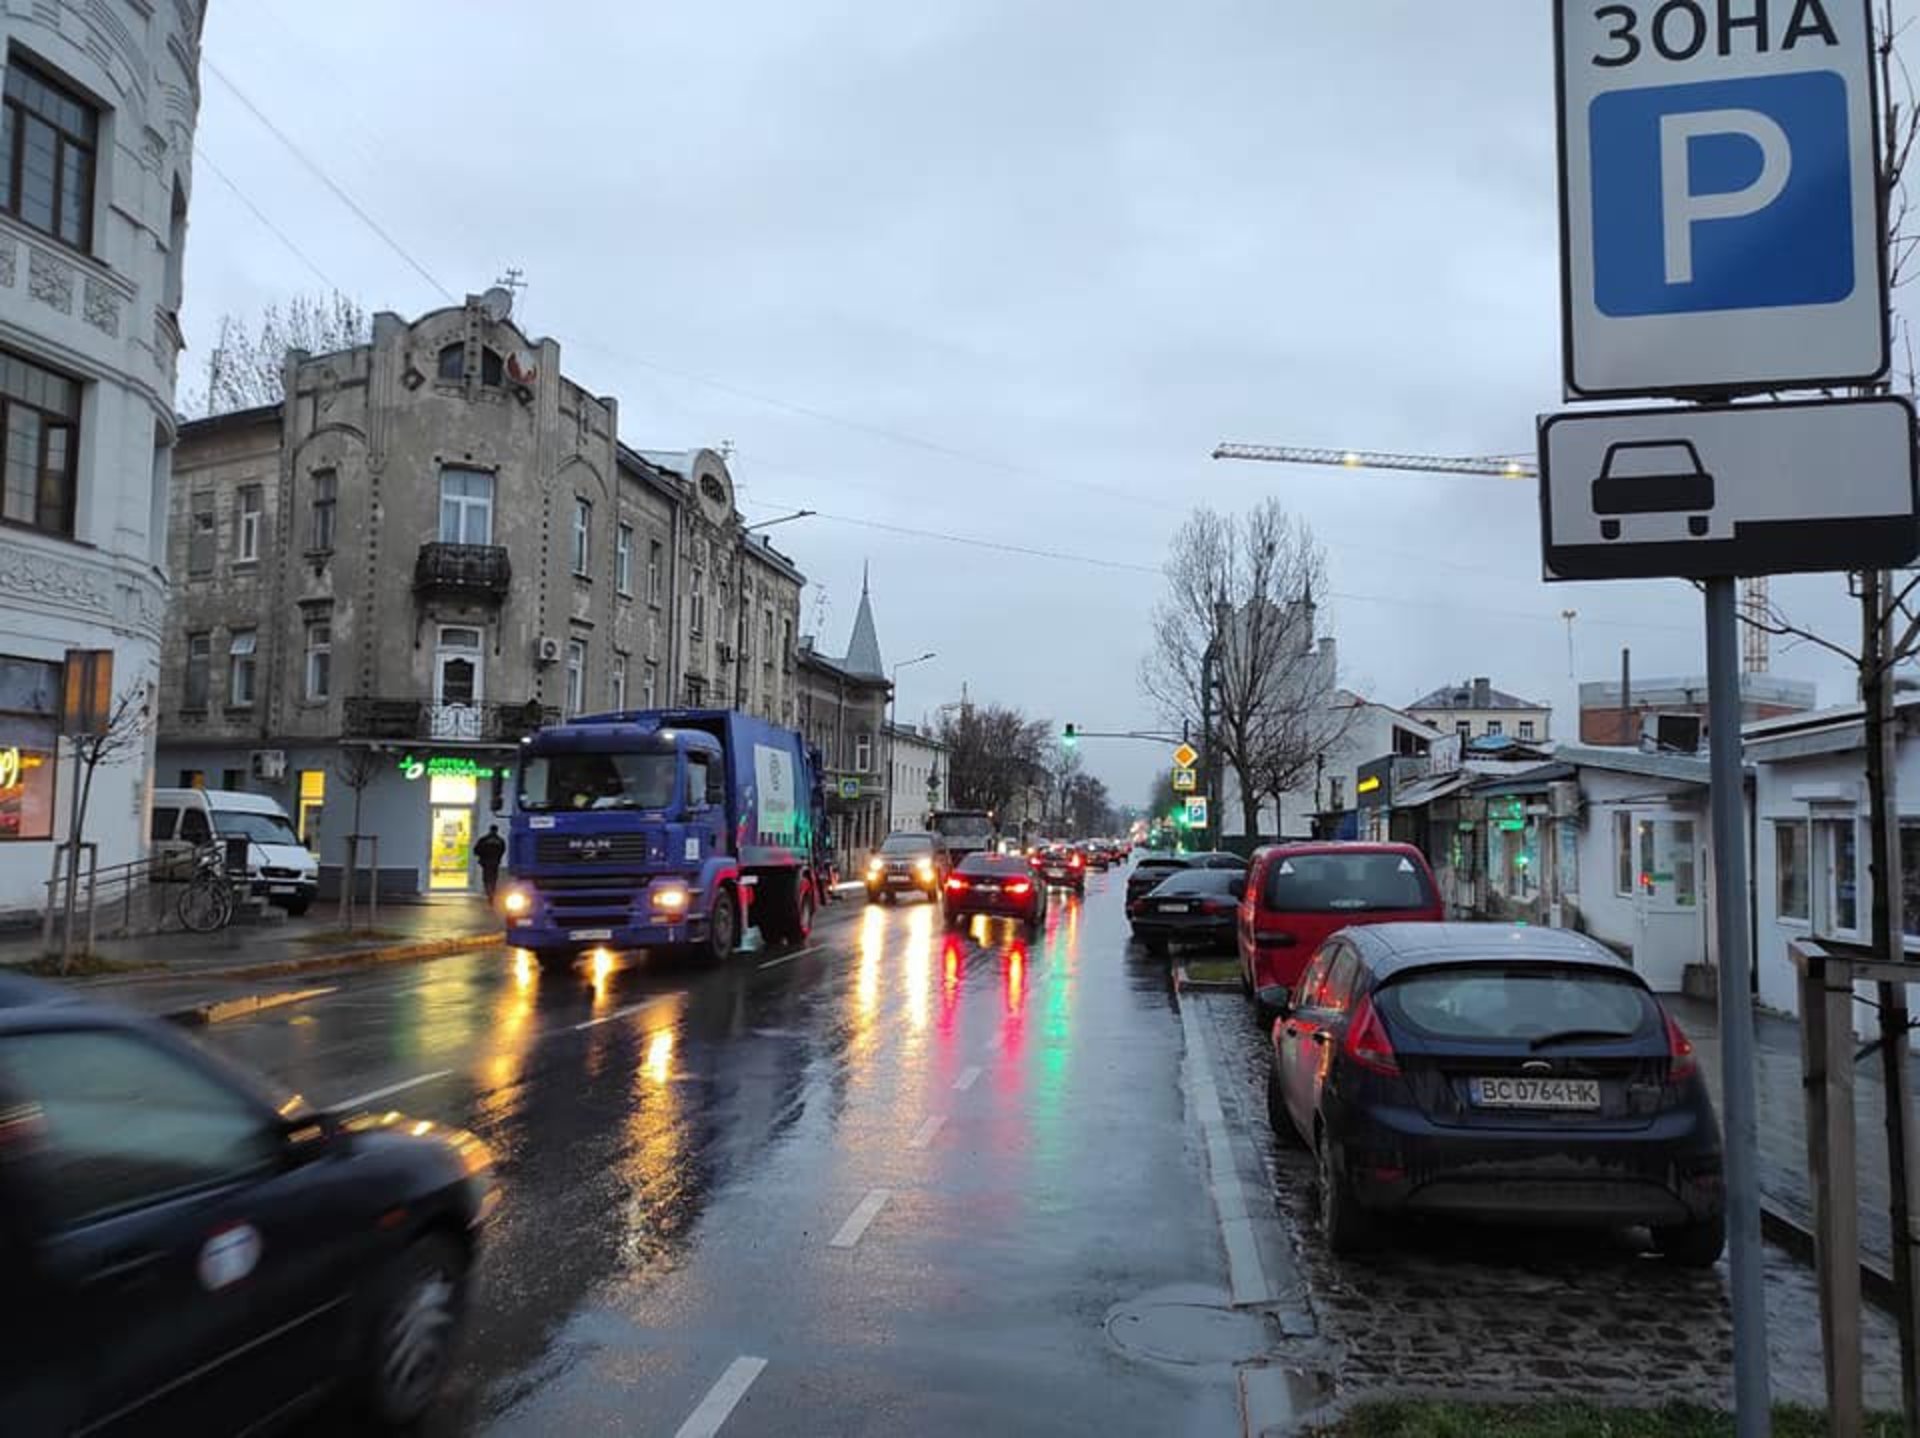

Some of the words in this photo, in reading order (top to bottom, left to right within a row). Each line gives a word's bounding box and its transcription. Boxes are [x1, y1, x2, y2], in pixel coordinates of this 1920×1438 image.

[1591, 0, 1839, 67] ЗОНА
[1660, 108, 1792, 284] P
[1482, 1079, 1512, 1099] BC
[1516, 1080, 1564, 1101] 0764
[1567, 1084, 1596, 1102] HK
